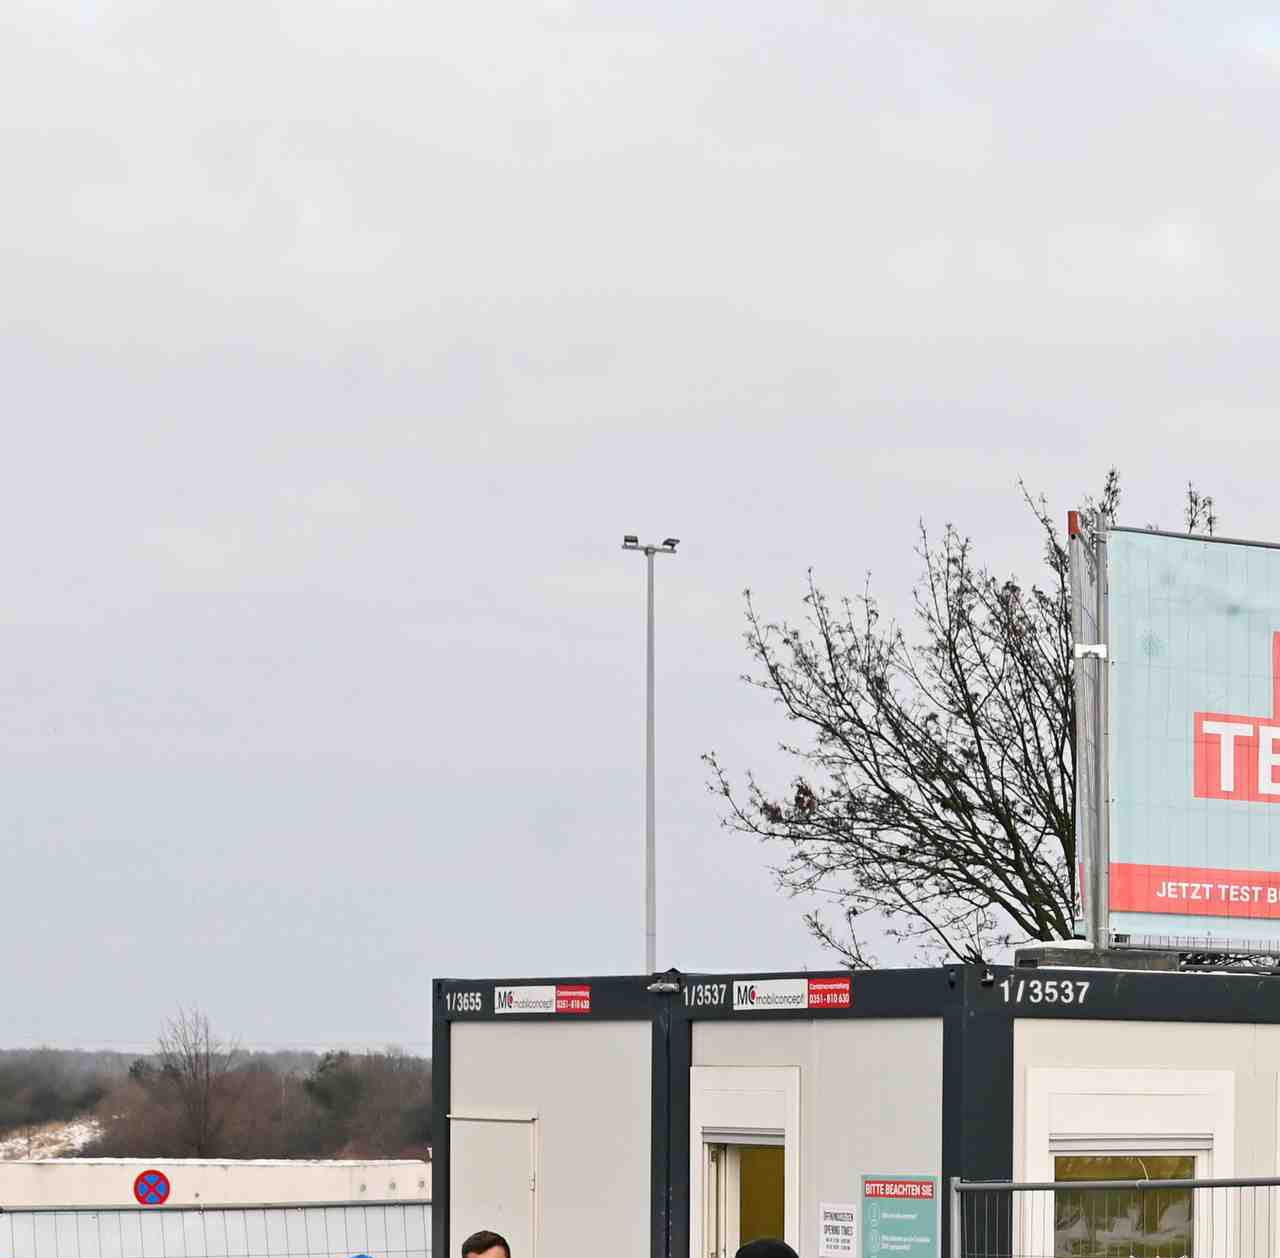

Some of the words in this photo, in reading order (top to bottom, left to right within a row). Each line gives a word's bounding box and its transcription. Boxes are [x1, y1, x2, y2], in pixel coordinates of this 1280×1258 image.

[1156, 881, 1214, 899] JETZT
[1218, 884, 1263, 903] TEST
[446, 992, 482, 1011] 1/3655
[683, 984, 727, 1007] 1/3537
[1000, 980, 1090, 1004] 1/3537
[865, 1183, 884, 1195] BITTE
[885, 1184, 920, 1196] BEACHTEN
[921, 1185, 932, 1196] SIE
